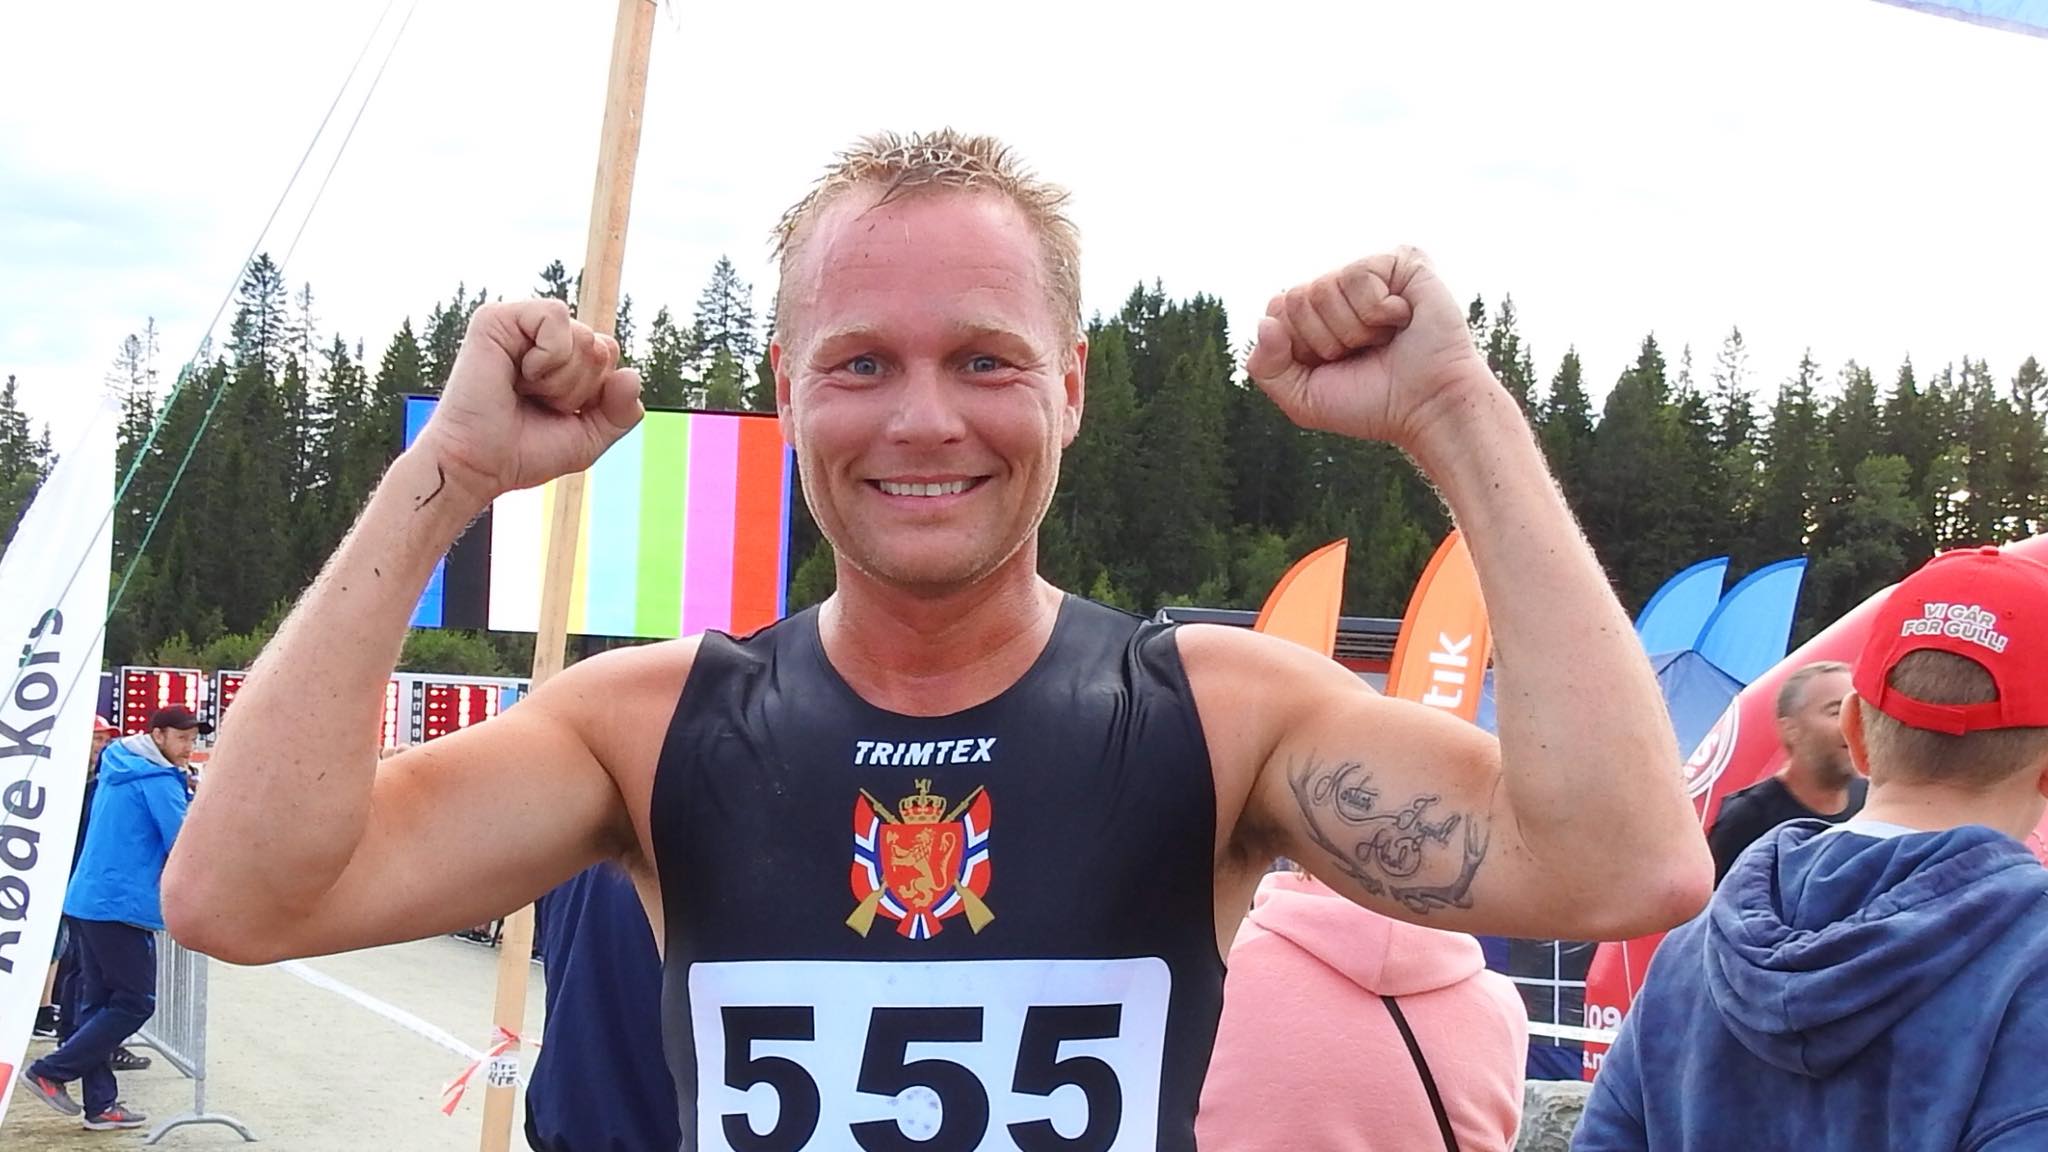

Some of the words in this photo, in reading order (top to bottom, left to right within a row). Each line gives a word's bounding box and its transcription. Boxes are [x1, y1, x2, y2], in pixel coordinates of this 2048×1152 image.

[1924, 602, 1949, 620] VI
[1948, 604, 1996, 629] GÅR
[1900, 619, 1943, 637] FOR
[1944, 620, 2009, 654] GULL!
[0, 608, 63, 760] Kors
[854, 737, 997, 766] TRIMTEX
[720, 1003, 1123, 1152] 555
